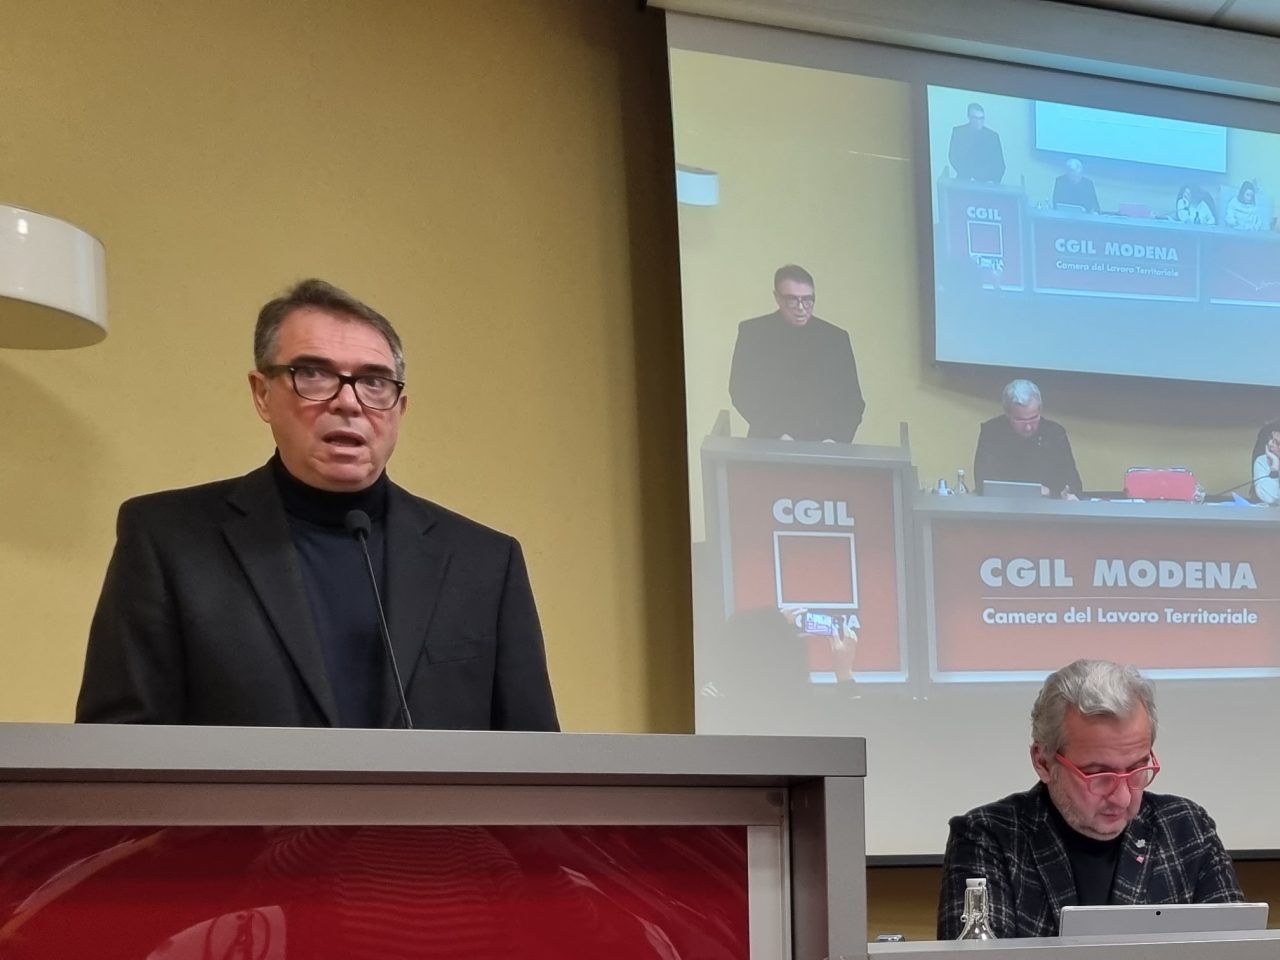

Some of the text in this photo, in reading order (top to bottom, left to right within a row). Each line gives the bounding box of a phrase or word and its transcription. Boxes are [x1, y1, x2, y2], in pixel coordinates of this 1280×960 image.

[1055, 238, 1179, 261] CGIL MODENA
[772, 498, 855, 526] CGIL
[980, 558, 1258, 589] CGIL MODENA
[982, 607, 1258, 625] Camera del Lavoro Territoriale
